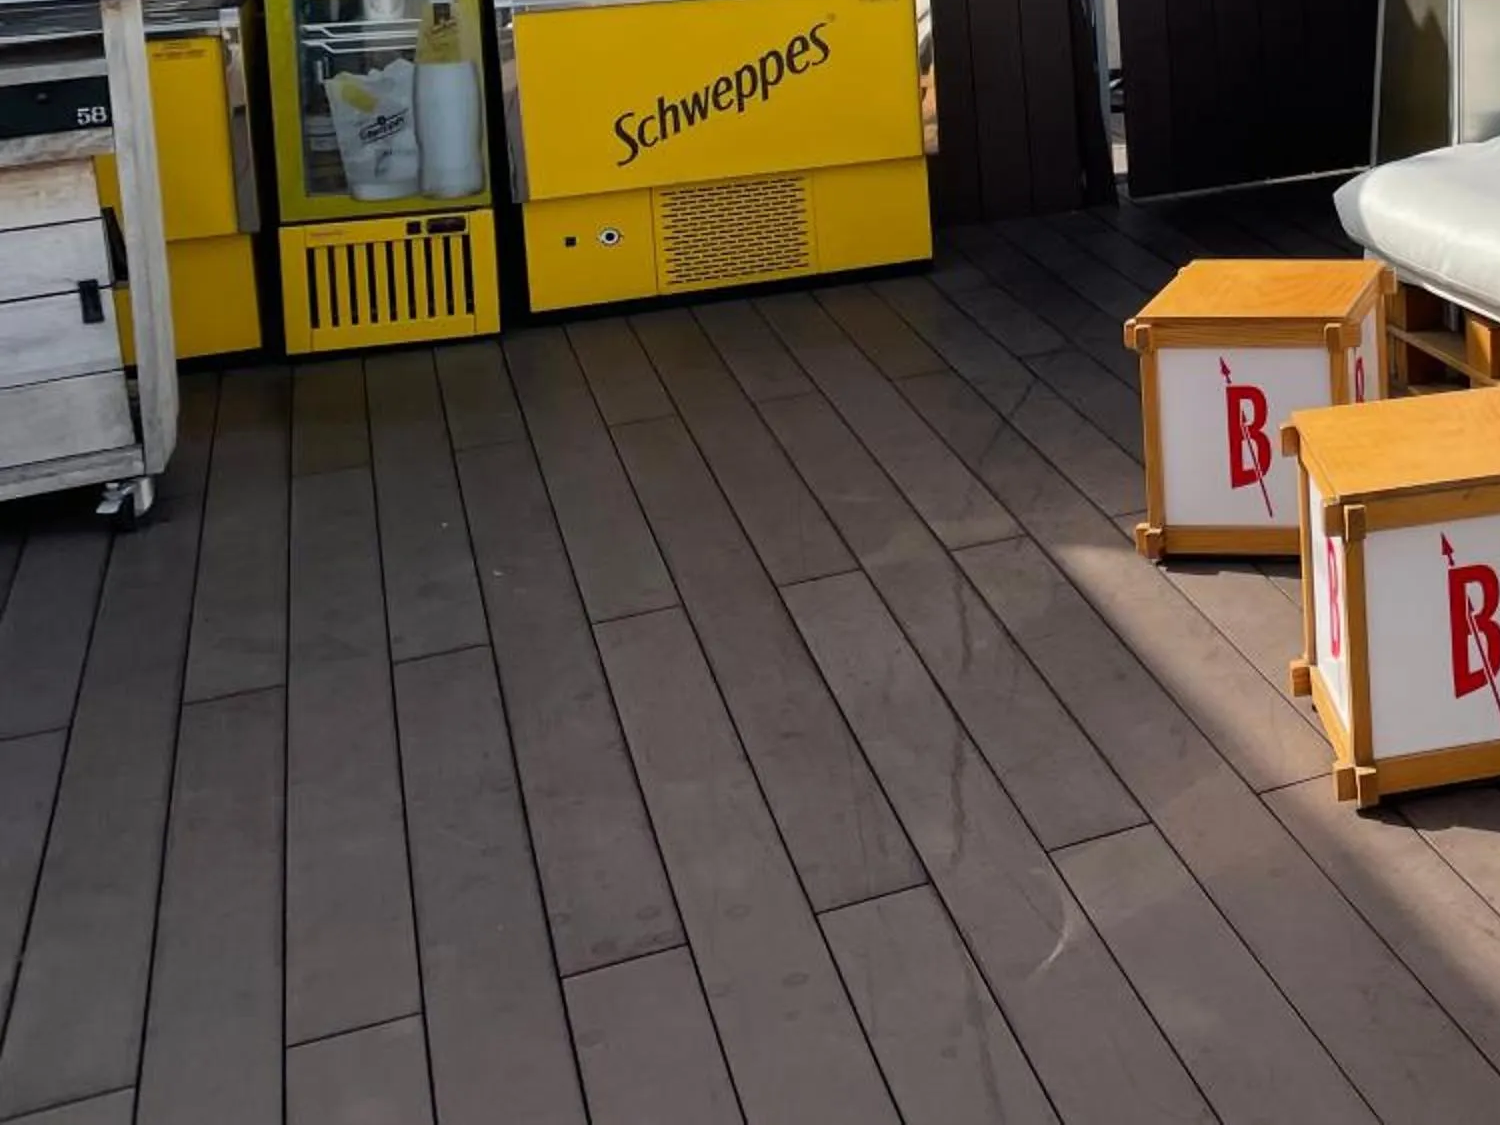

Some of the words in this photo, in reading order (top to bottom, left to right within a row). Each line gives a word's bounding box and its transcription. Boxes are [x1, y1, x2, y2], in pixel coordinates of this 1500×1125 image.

[76, 106, 108, 126] 58
[614, 21, 832, 168] Schweppes
[1226, 385, 1272, 489] B
